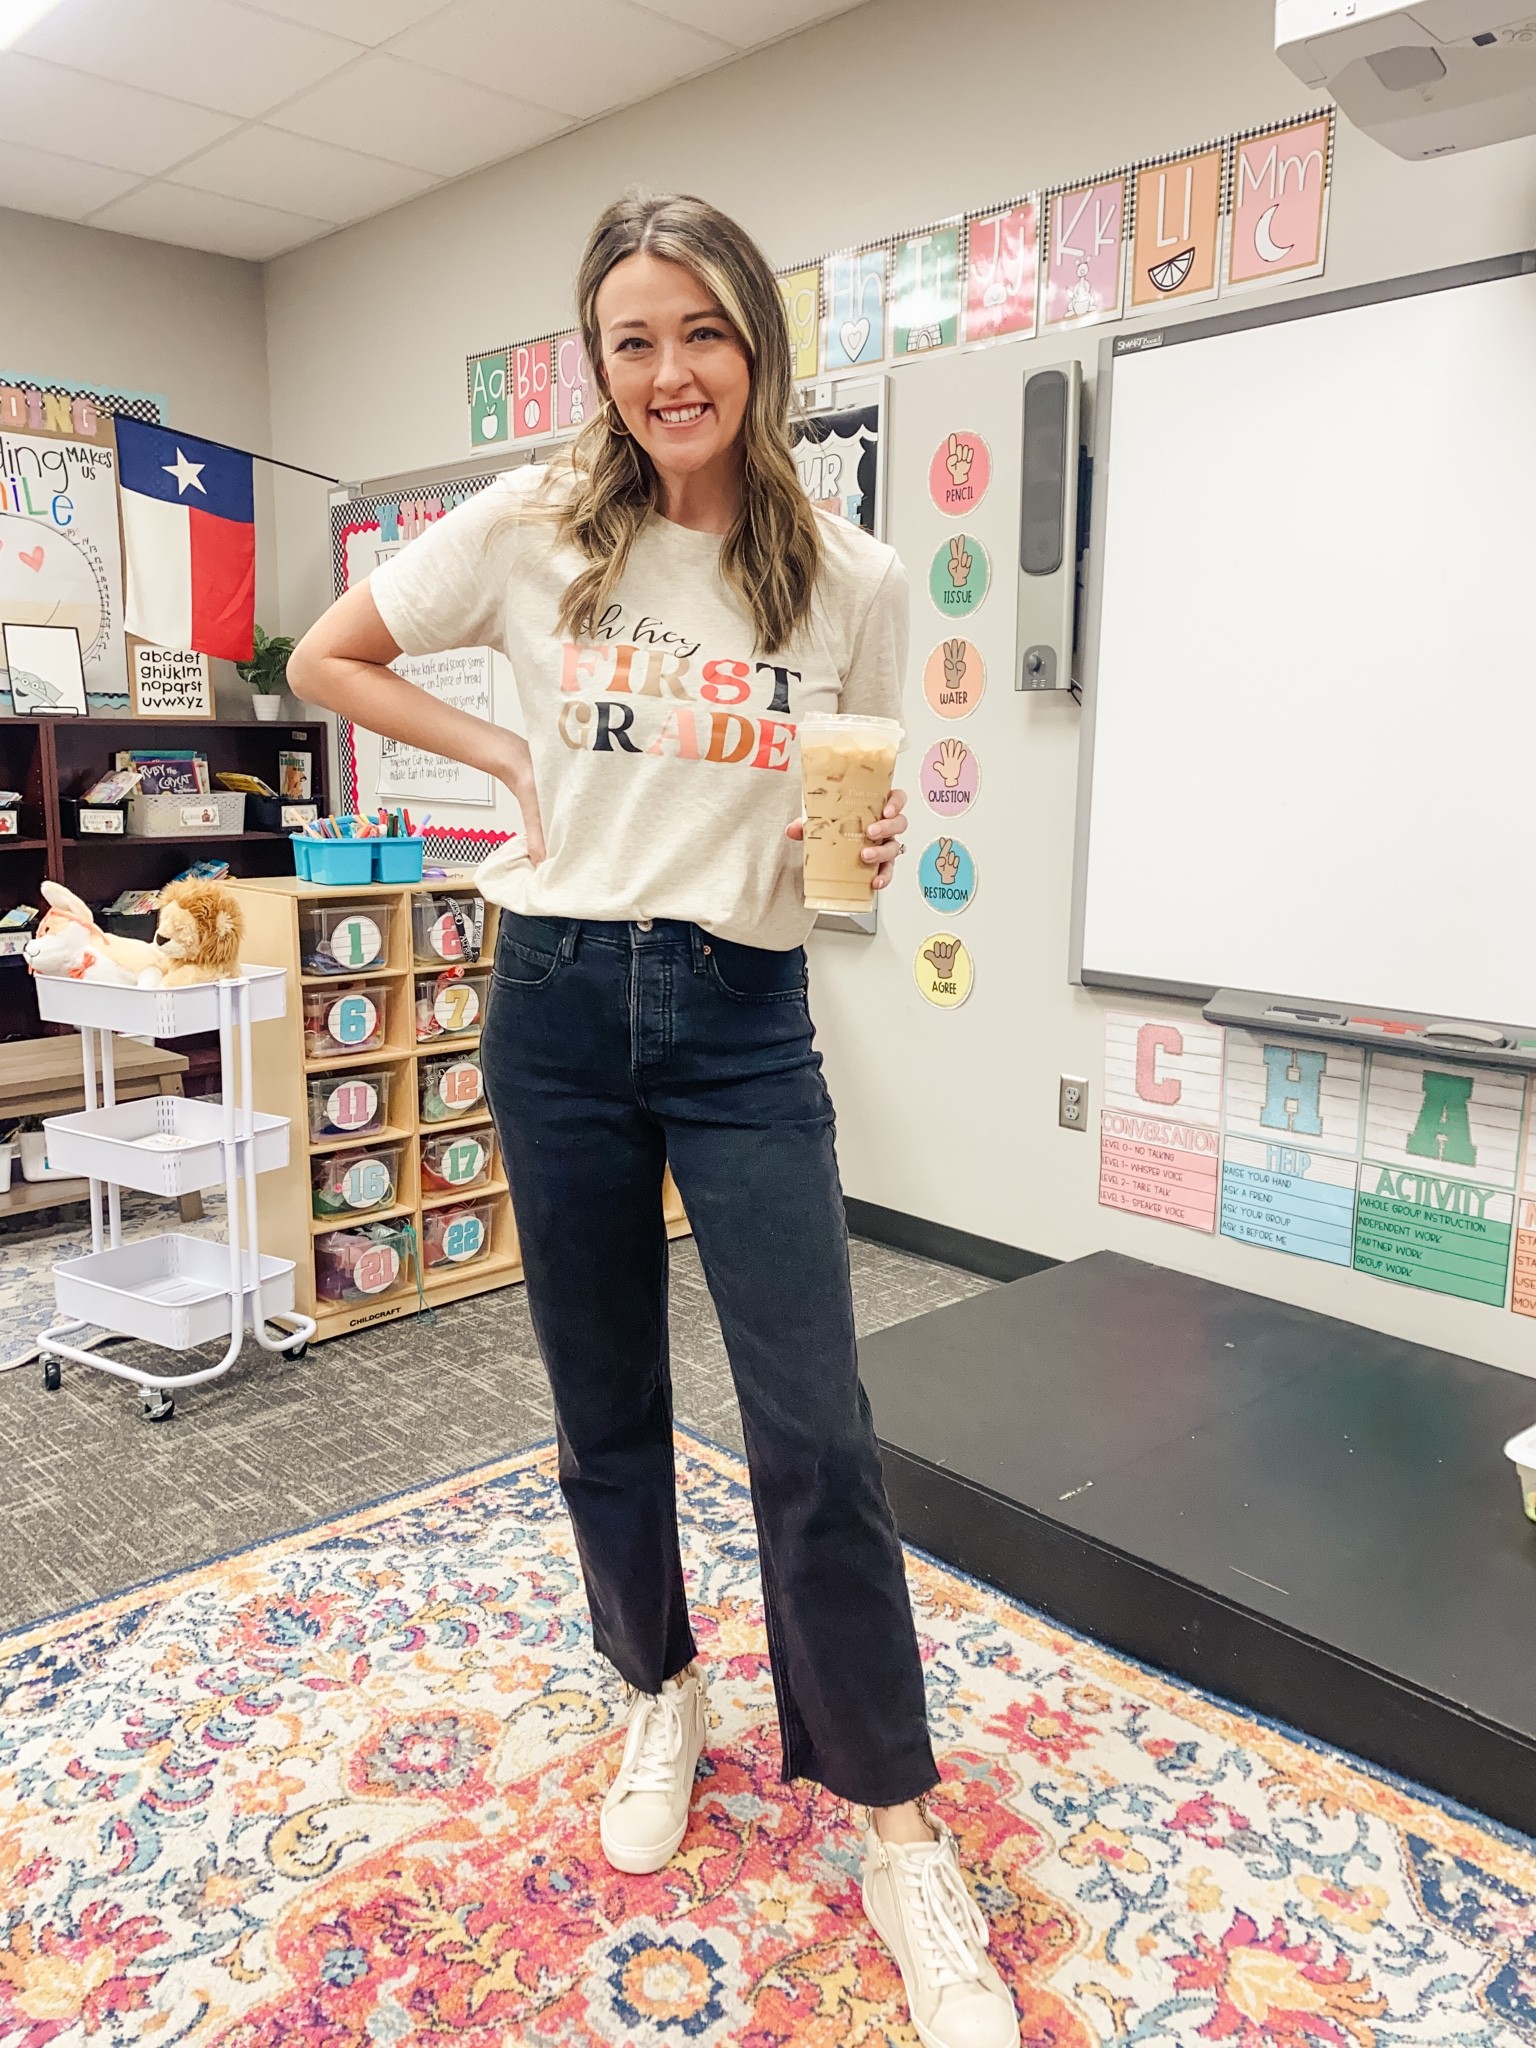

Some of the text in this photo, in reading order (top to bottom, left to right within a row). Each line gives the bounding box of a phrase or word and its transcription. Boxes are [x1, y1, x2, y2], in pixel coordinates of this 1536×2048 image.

[1237, 144, 1324, 209] Mm
[1156, 166, 1194, 248] Ll
[1056, 187, 1116, 266] Kk
[904, 235, 942, 303] Ii
[972, 208, 1025, 296] Jj
[828, 254, 884, 320] Hh
[1117, 338, 1142, 351] SMART
[472, 361, 506, 407] Aa
[516, 348, 548, 400] Bb
[81, 465, 96, 480] US
[797, 453, 842, 501] UR
[945, 486, 974, 503] PENCIL
[943, 590, 973, 604] TISSUE
[632, 616, 702, 659] hey
[140, 650, 201, 665] abcdef
[141, 664, 202, 680] ghijklm
[437, 658, 449, 672] and
[449, 657, 466, 671] scoop
[467, 657, 485, 669] some
[141, 680, 203, 695] nopqrst
[560, 642, 802, 714] FIRST
[142, 696, 203, 709] uvwxyz
[939, 690, 968, 705] WATER
[381, 736, 398, 756] Last
[558, 701, 797, 772] GRADE
[138, 764, 166, 780] RUBY
[928, 790, 970, 804] QUESTION
[924, 886, 969, 901] RESTROOM
[348, 922, 366, 965] 1
[442, 915, 464, 956] 2
[931, 981, 957, 995] AGREE
[340, 998, 366, 1043] 6
[446, 988, 470, 1028] 7
[1135, 1022, 1184, 1107] C
[445, 1069, 478, 1103] 12
[1260, 1043, 1327, 1138] H
[336, 1086, 369, 1124] 11
[1406, 1069, 1478, 1167] A
[1101, 1112, 1219, 1155] CONVERSATION
[1102, 1139, 1120, 1150] LEVEL
[1135, 1146, 1145, 1155] NO
[1148, 1149, 1175, 1162] TALKING
[448, 1143, 479, 1181] 17
[1102, 1156, 1119, 1167] LEVEL
[1130, 1163, 1160, 1176] WHISPER
[1162, 1170, 1183, 1182] VOICE
[1224, 1165, 1292, 1189] RAISE YOUR HAND
[1266, 1144, 1311, 1179] HELP
[348, 1166, 387, 1203] 16
[1101, 1173, 1119, 1185] LEVEL
[1132, 1180, 1151, 1193] TABLE
[1154, 1186, 1172, 1197] TALK
[1223, 1185, 1240, 1195] ASK
[1249, 1190, 1273, 1203] FRIEND
[1375, 1168, 1496, 1218] ACTIVITY
[1101, 1191, 1118, 1203] LEVEL
[1132, 1198, 1162, 1212] SPEAKER
[1164, 1206, 1185, 1218] VOICE
[1222, 1203, 1291, 1227] ASK YOUR GROUP
[1360, 1197, 1487, 1233] WHOLE GROUP INSTRUCTION
[447, 1219, 480, 1255] 22
[1222, 1221, 1287, 1246] ASK 3 BEFORE ME
[1359, 1216, 1443, 1244] INDEPENDENT WORK
[1357, 1236, 1423, 1260] PARTNER WORK
[361, 1250, 394, 1290] 21
[1355, 1255, 1413, 1277] GROUP WORK
[350, 1307, 402, 1327] CHILDCRAFT
